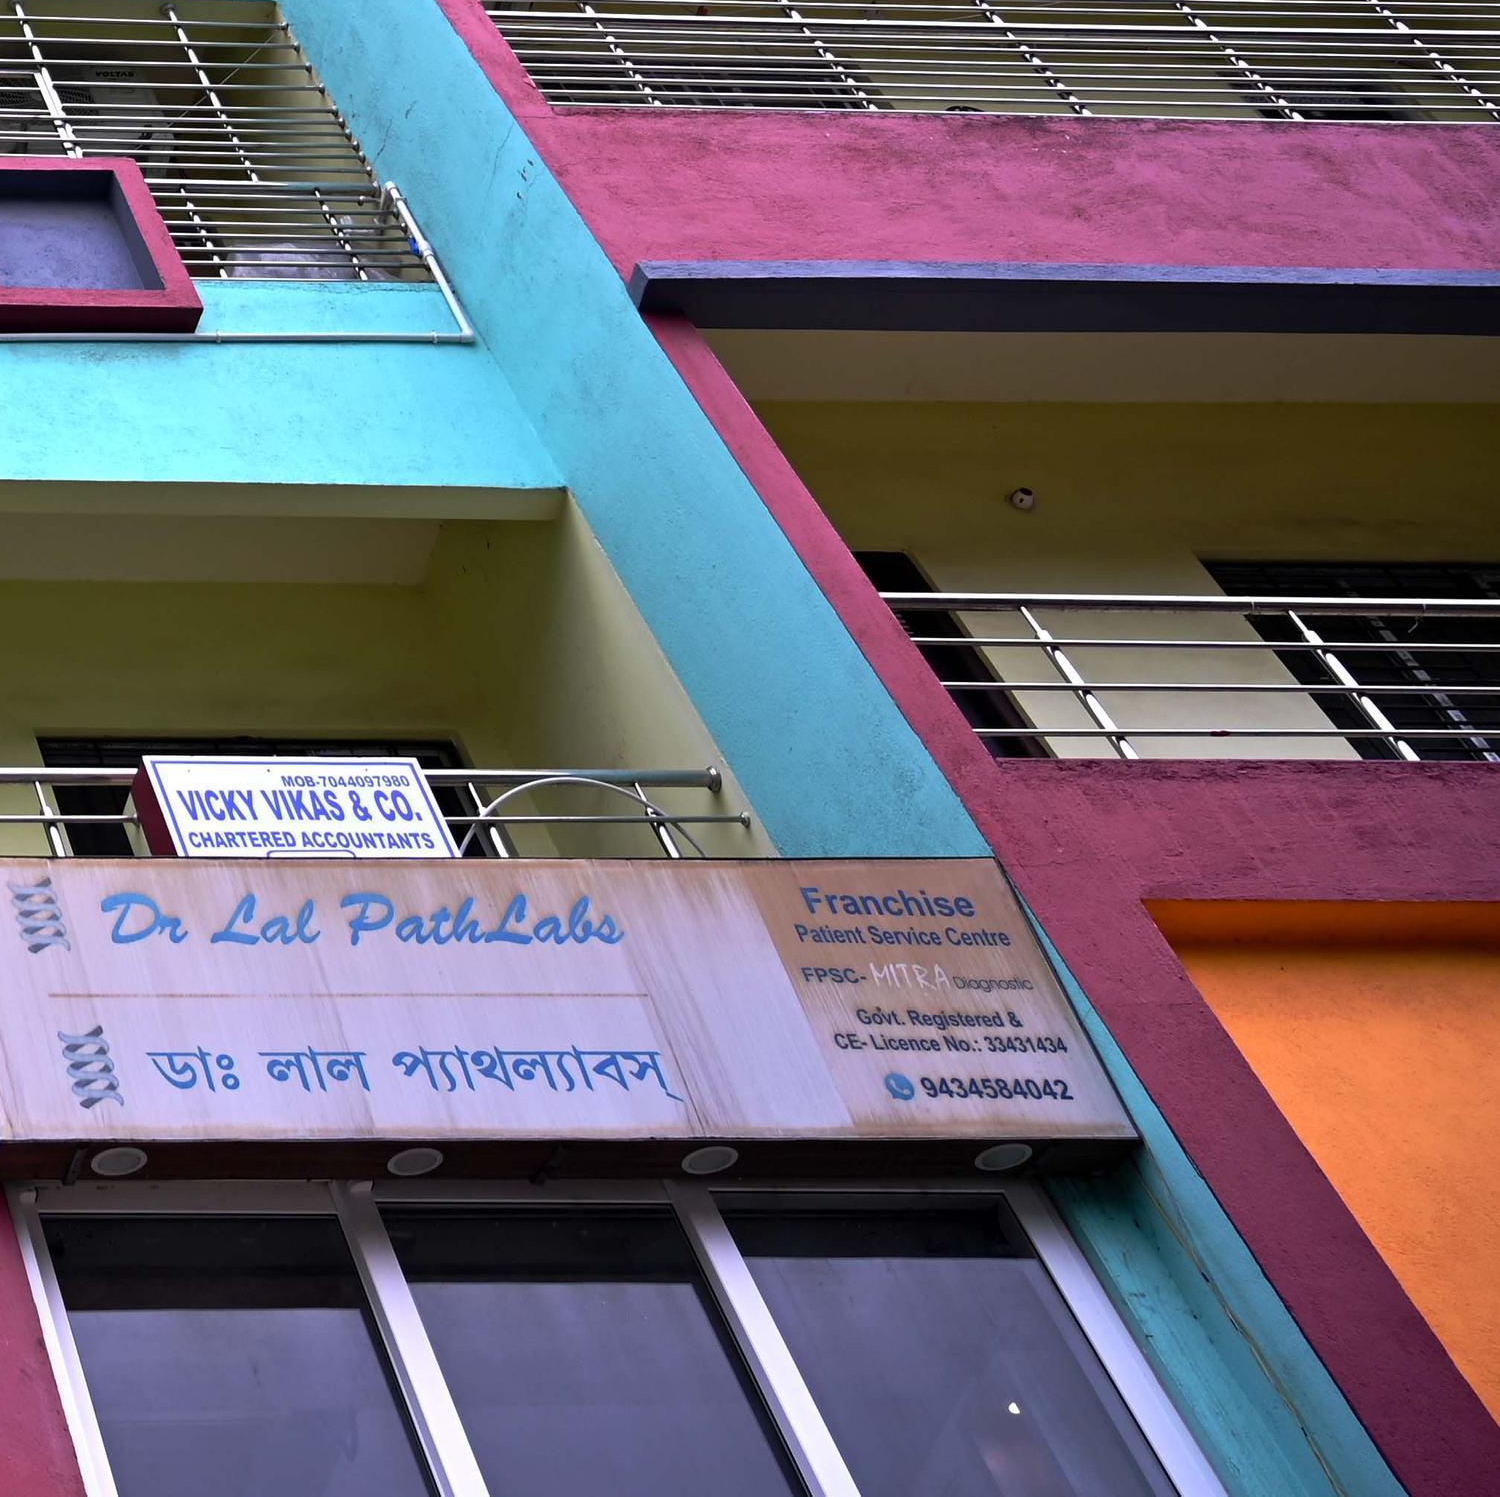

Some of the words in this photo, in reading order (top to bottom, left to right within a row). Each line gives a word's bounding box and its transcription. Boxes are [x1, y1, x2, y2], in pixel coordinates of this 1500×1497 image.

[95, 70, 135, 78] VOLTAS
[281, 775, 410, 788] MOB-7044097980
[176, 789, 258, 821] VICKY
[260, 789, 345, 821] VIKAS
[349, 790, 373, 821] &
[374, 790, 423, 822] CO.
[189, 831, 297, 849] CHARTERED
[301, 831, 435, 850] ACCOUNTANTS
[799, 886, 976, 918] Franchise
[100, 892, 190, 946] Dr
[209, 892, 321, 947] Lal
[340, 893, 625, 946] PathLabs
[794, 923, 867, 945] Patient
[867, 925, 943, 946] Service
[945, 927, 1012, 948] Centre
[801, 967, 867, 984] FPSC-
[869, 961, 951, 992] MITRA
[952, 975, 1034, 993] Diagnostic
[856, 1008, 905, 1026] Govt.
[910, 1010, 1003, 1031] Registered
[1009, 1011, 1023, 1027] &
[834, 1033, 868, 1050] CE-
[872, 1035, 940, 1051] Licence
[987, 1037, 1068, 1054] 33431434
[258, 1048, 371, 1093] লাল
[920, 1076, 1074, 1101] 9434584042
